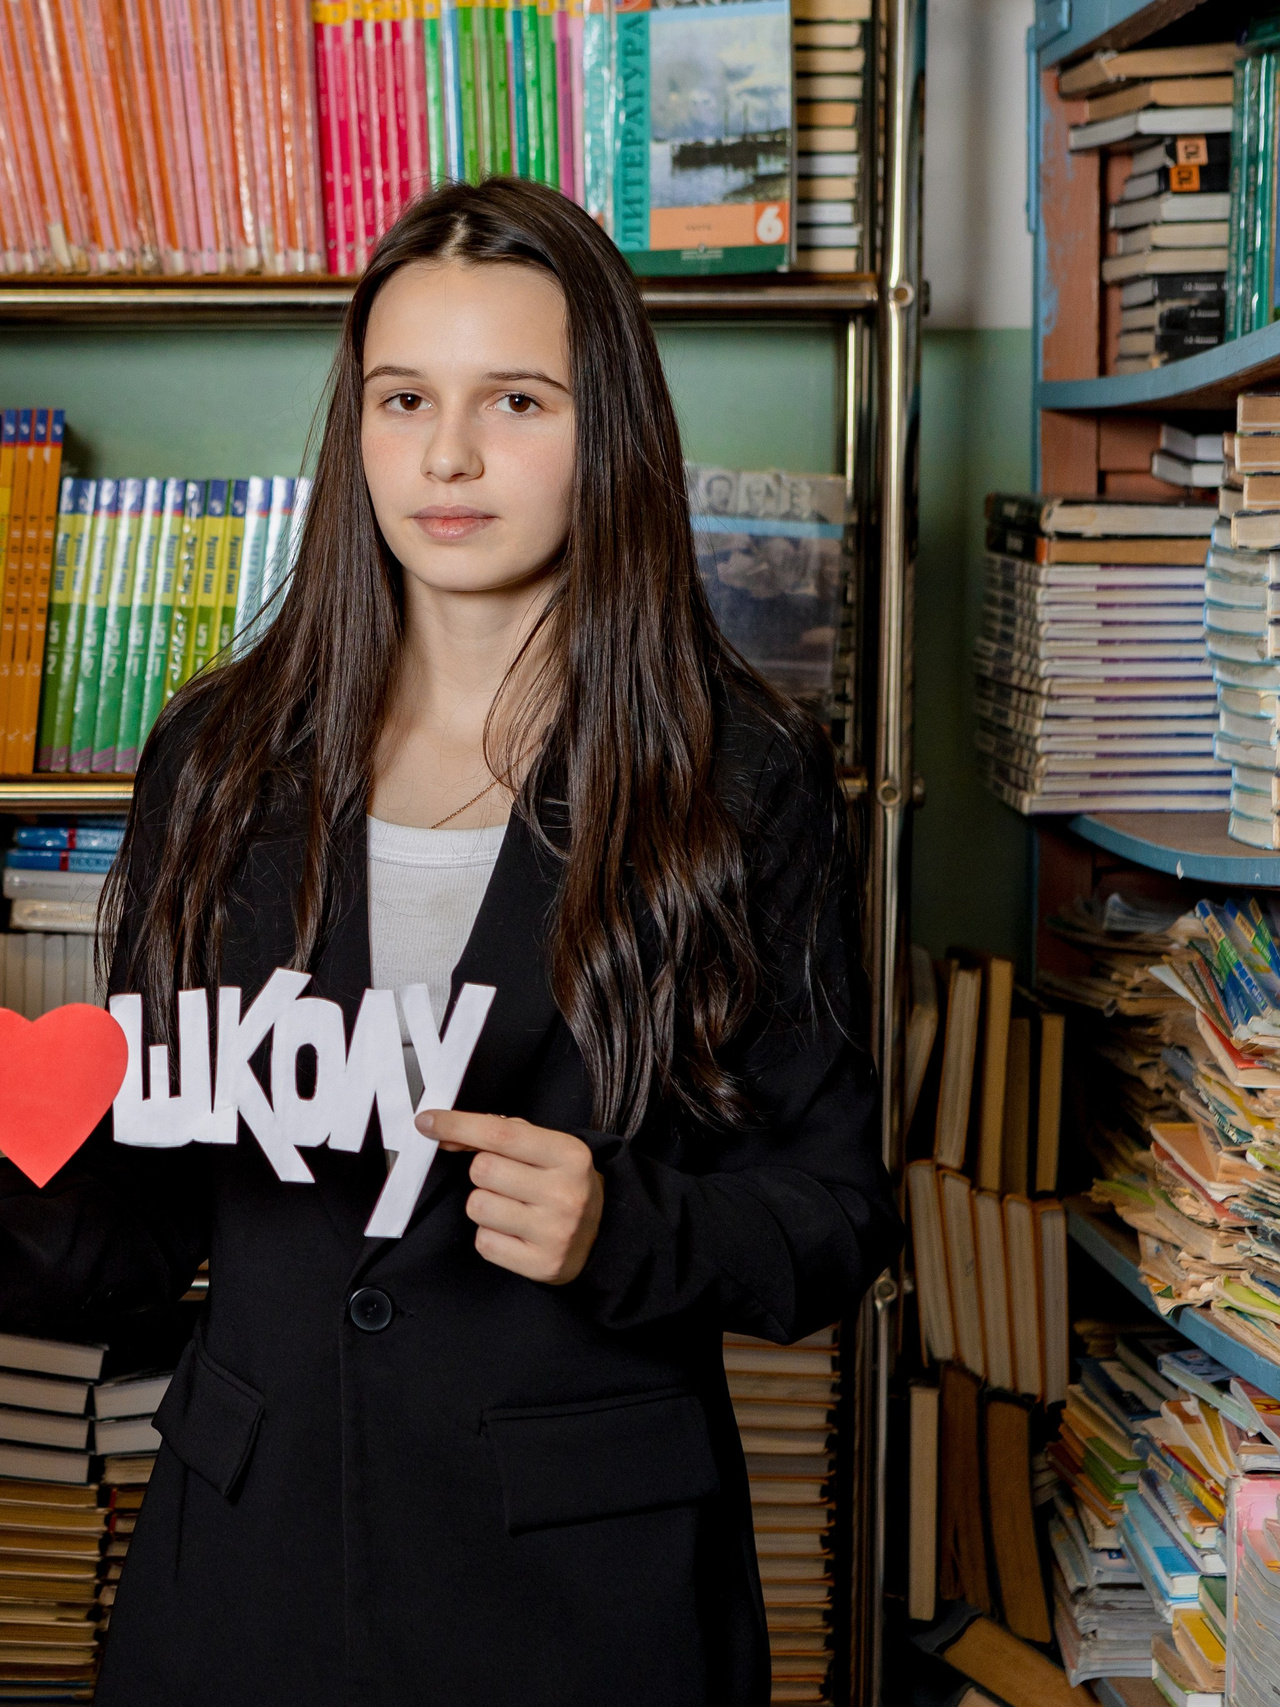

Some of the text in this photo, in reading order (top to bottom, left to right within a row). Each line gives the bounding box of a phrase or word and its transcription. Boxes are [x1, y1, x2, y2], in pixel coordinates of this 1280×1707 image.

[622, 14, 645, 248] ЛИТЕРАТУРА
[756, 205, 784, 244] 6
[49, 621, 60, 644] 5
[109, 624, 121, 646] 5
[132, 623, 144, 646] 5
[154, 623, 166, 646] 5
[197, 623, 208, 647] 5
[47, 652, 57, 674] 2
[107, 655, 118, 678] 2
[132, 655, 140, 677] 1
[154, 655, 162, 677] 1
